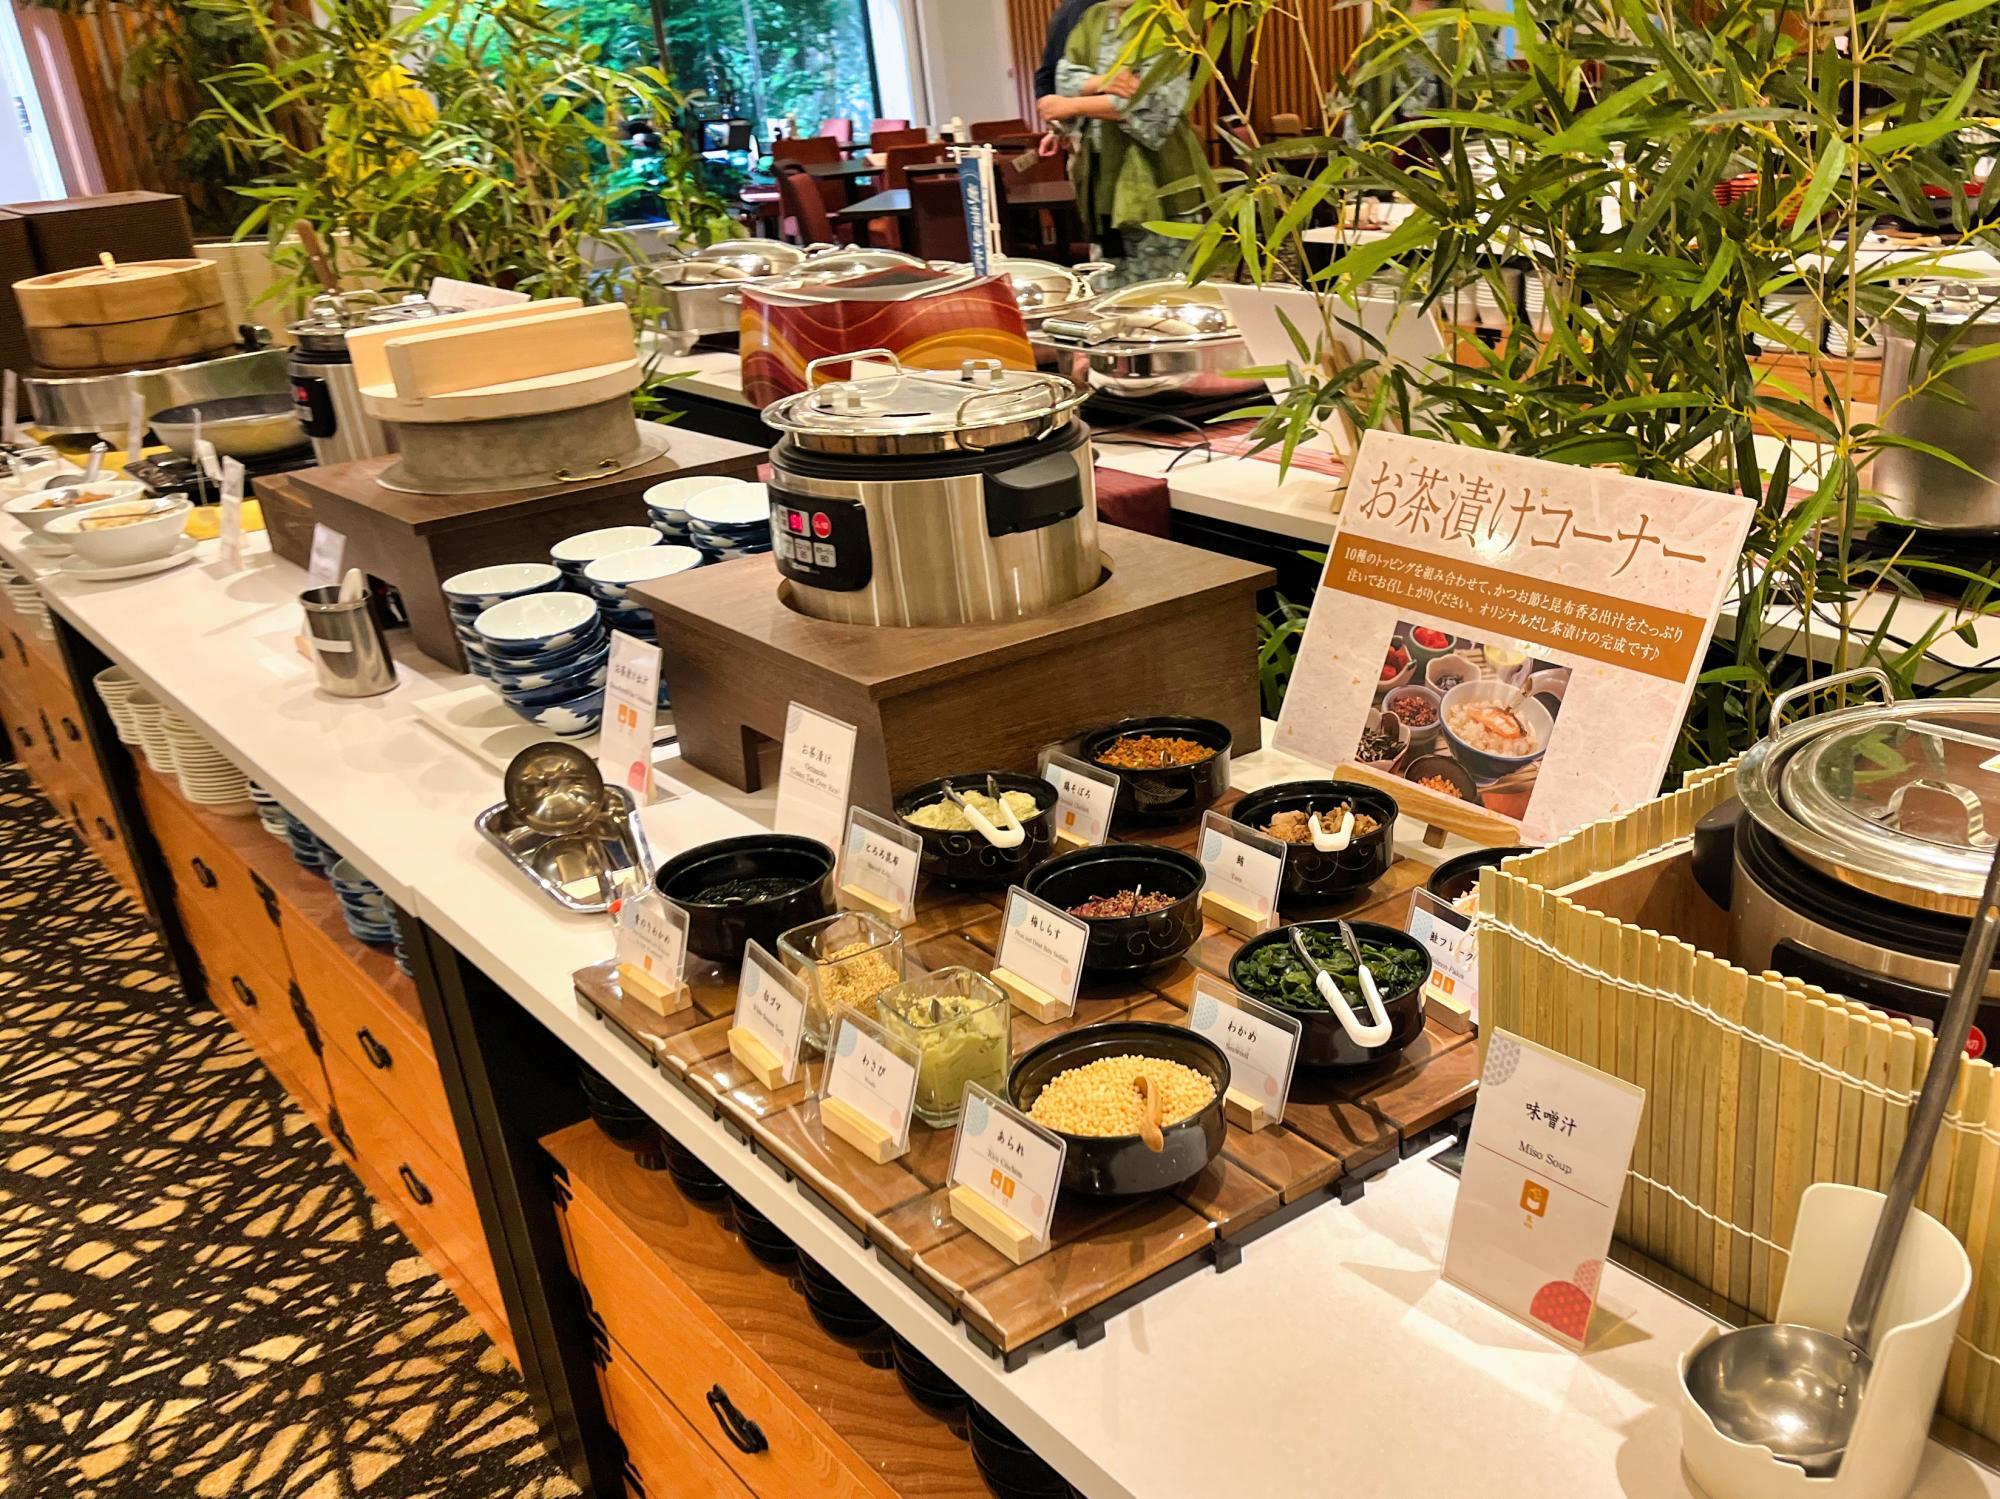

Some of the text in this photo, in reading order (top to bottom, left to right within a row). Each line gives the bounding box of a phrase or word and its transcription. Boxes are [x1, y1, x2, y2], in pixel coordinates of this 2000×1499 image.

[1359, 460, 1707, 578] お茶漬けコーナー
[1344, 547, 1684, 644] 10種のトッピングを組み合わせて、かつお節と昆布香る出汁をたっぷり
[865, 843, 901, 867] とろろ昆布
[1030, 915, 1062, 941] 梅しらす
[1227, 1020, 1257, 1043] わかめ
[862, 1054, 887, 1079] わさび
[1525, 1101, 1578, 1138] 味噌汁
[997, 1130, 1024, 1157] あられ
[1518, 1139, 1573, 1175] Miso Soup
